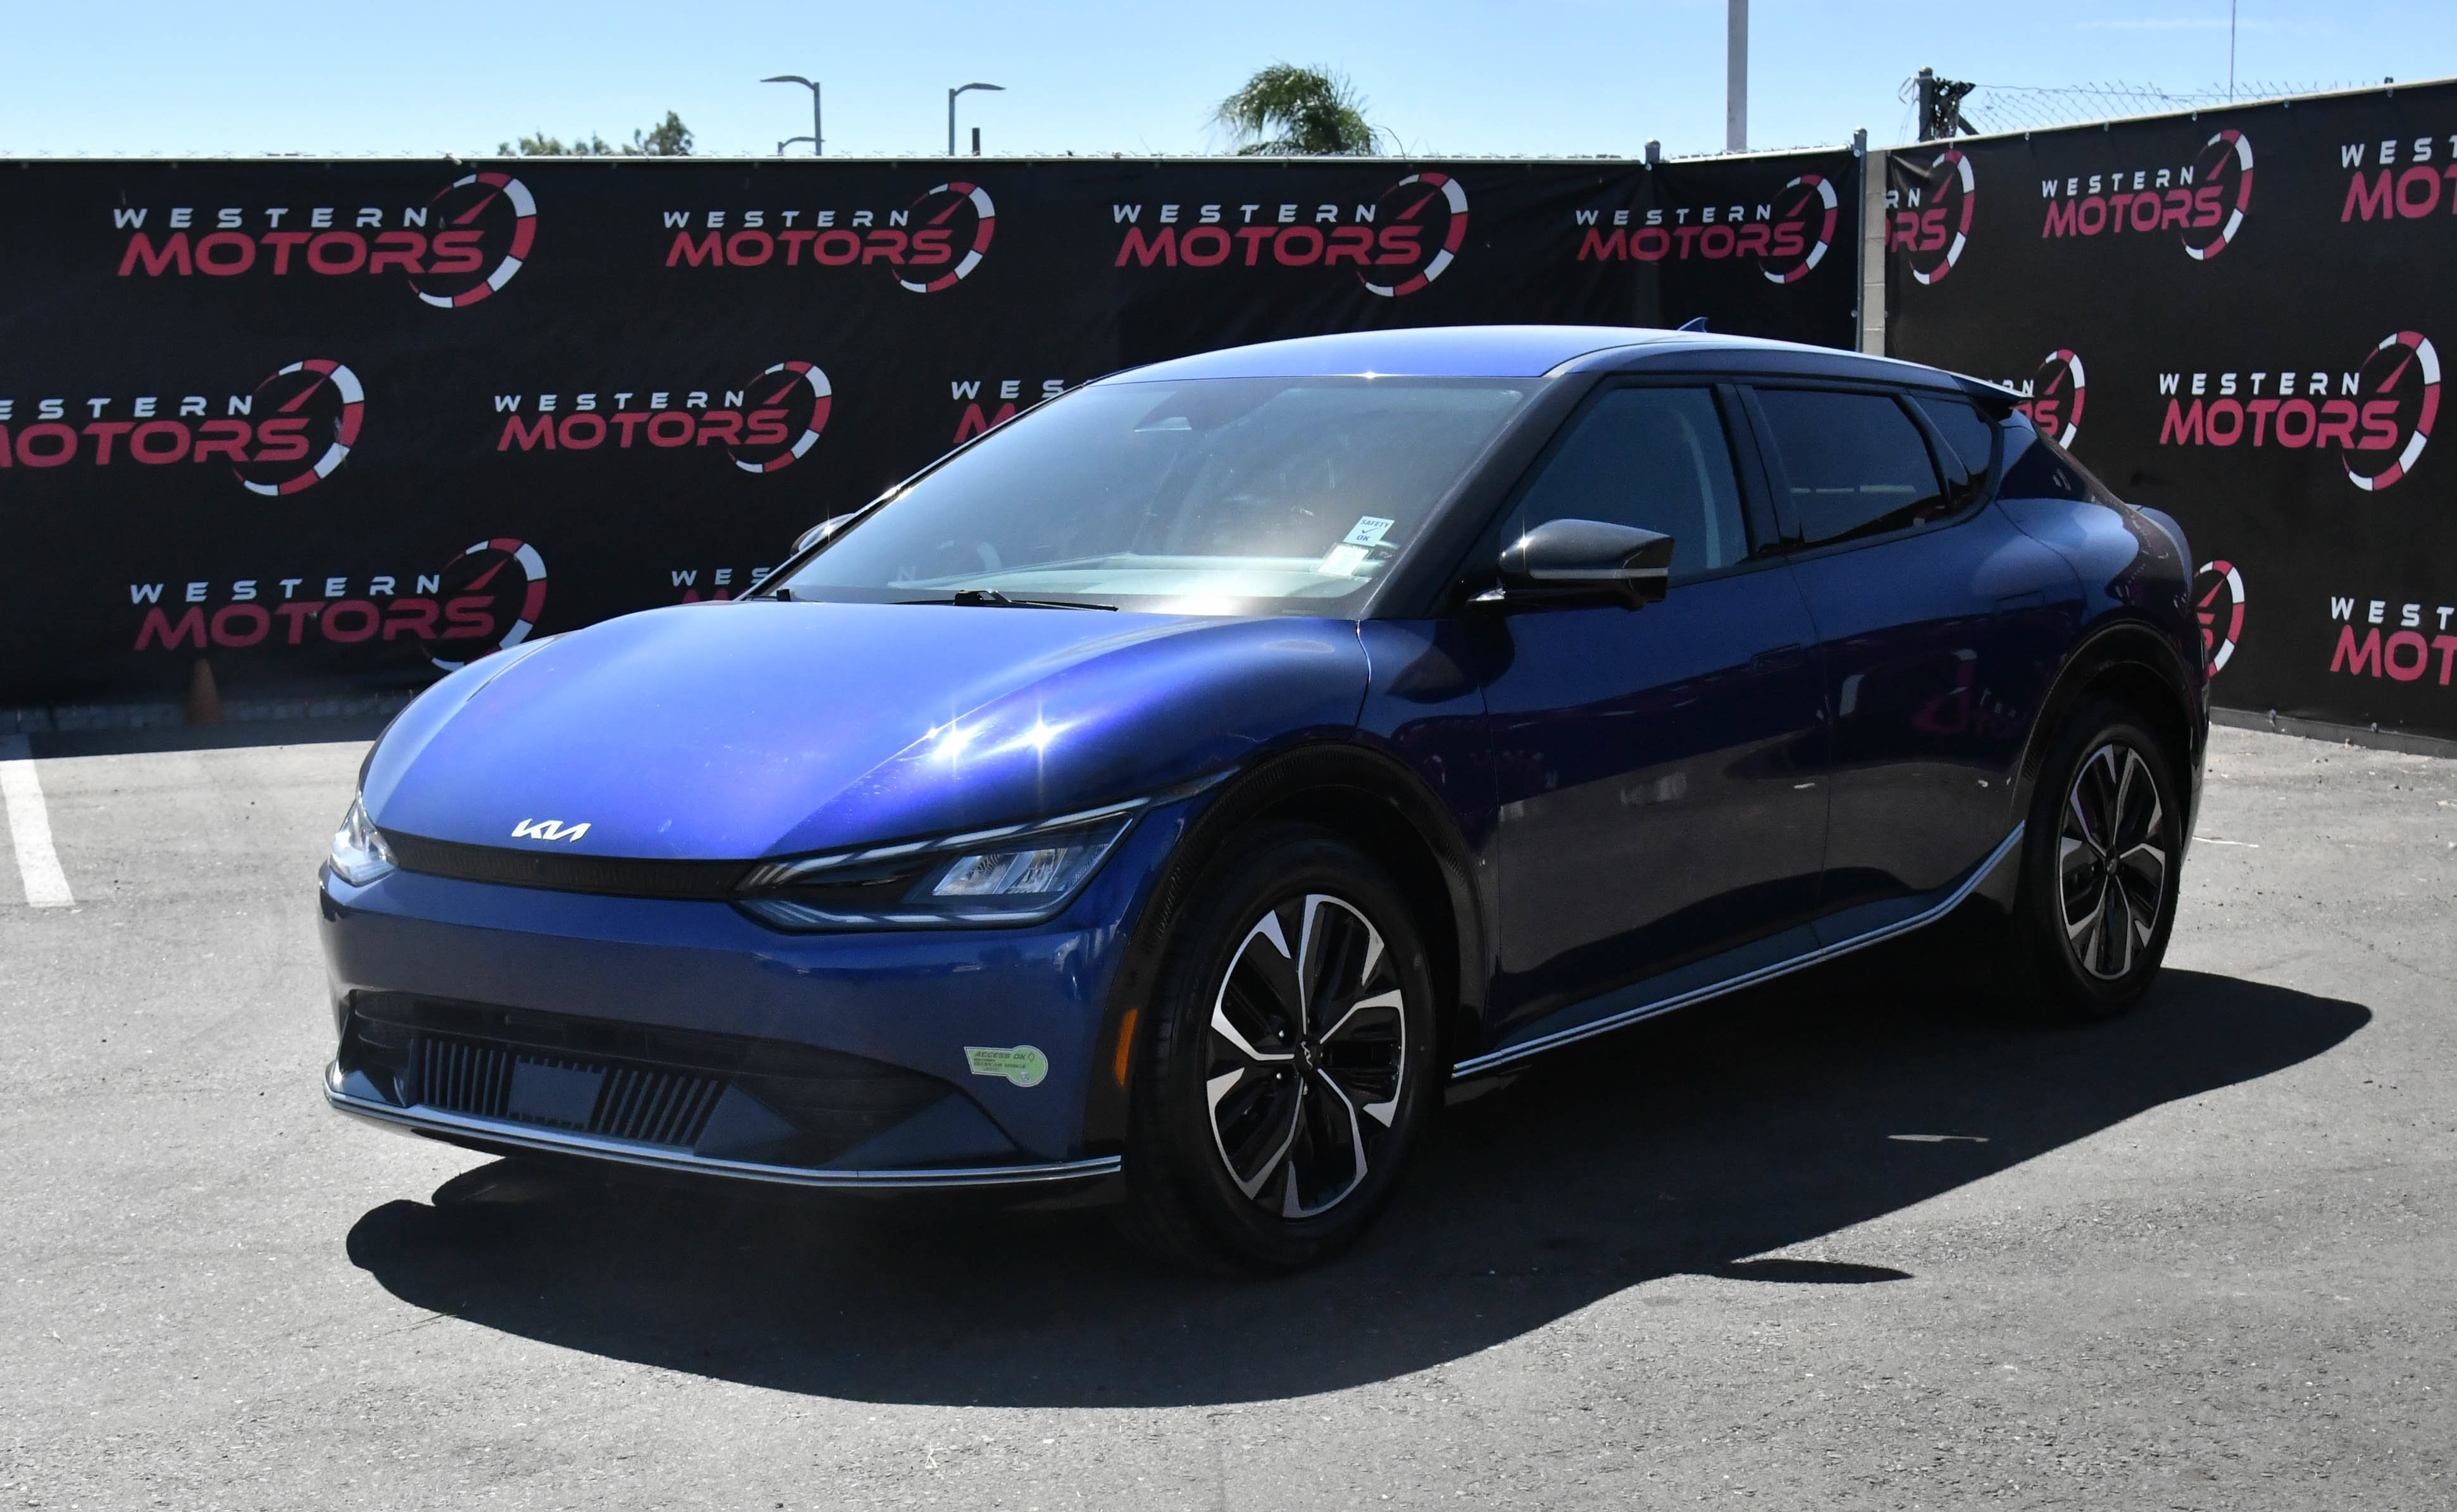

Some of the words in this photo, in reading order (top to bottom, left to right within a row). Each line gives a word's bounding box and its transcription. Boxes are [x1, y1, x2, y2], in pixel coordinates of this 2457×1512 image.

[2043, 166, 2194, 197] WESTERN
[114, 208, 426, 228] WESTERN
[664, 211, 909, 228] WESTERN
[1114, 204, 1376, 223] WESTERN
[1576, 205, 1770, 225] WESTERN
[2043, 187, 2224, 239] MOTORS
[118, 231, 483, 276] MOTORS
[666, 230, 953, 267] MOTORS
[1116, 226, 1422, 267] MOTORS
[1577, 222, 1805, 261] MOTORS
[2160, 372, 2360, 395] WESTERN
[495, 390, 743, 412] WESTERN
[497, 410, 788, 452] MOTORS
[2159, 399, 2400, 451] MOTORS
[0, 419, 310, 467] OTORS
[1360, 519, 1390, 528] SAFETY
[130, 575, 439, 605] WESTERN
[134, 597, 493, 650] MOTORS
[511, 818, 592, 843] KIA
